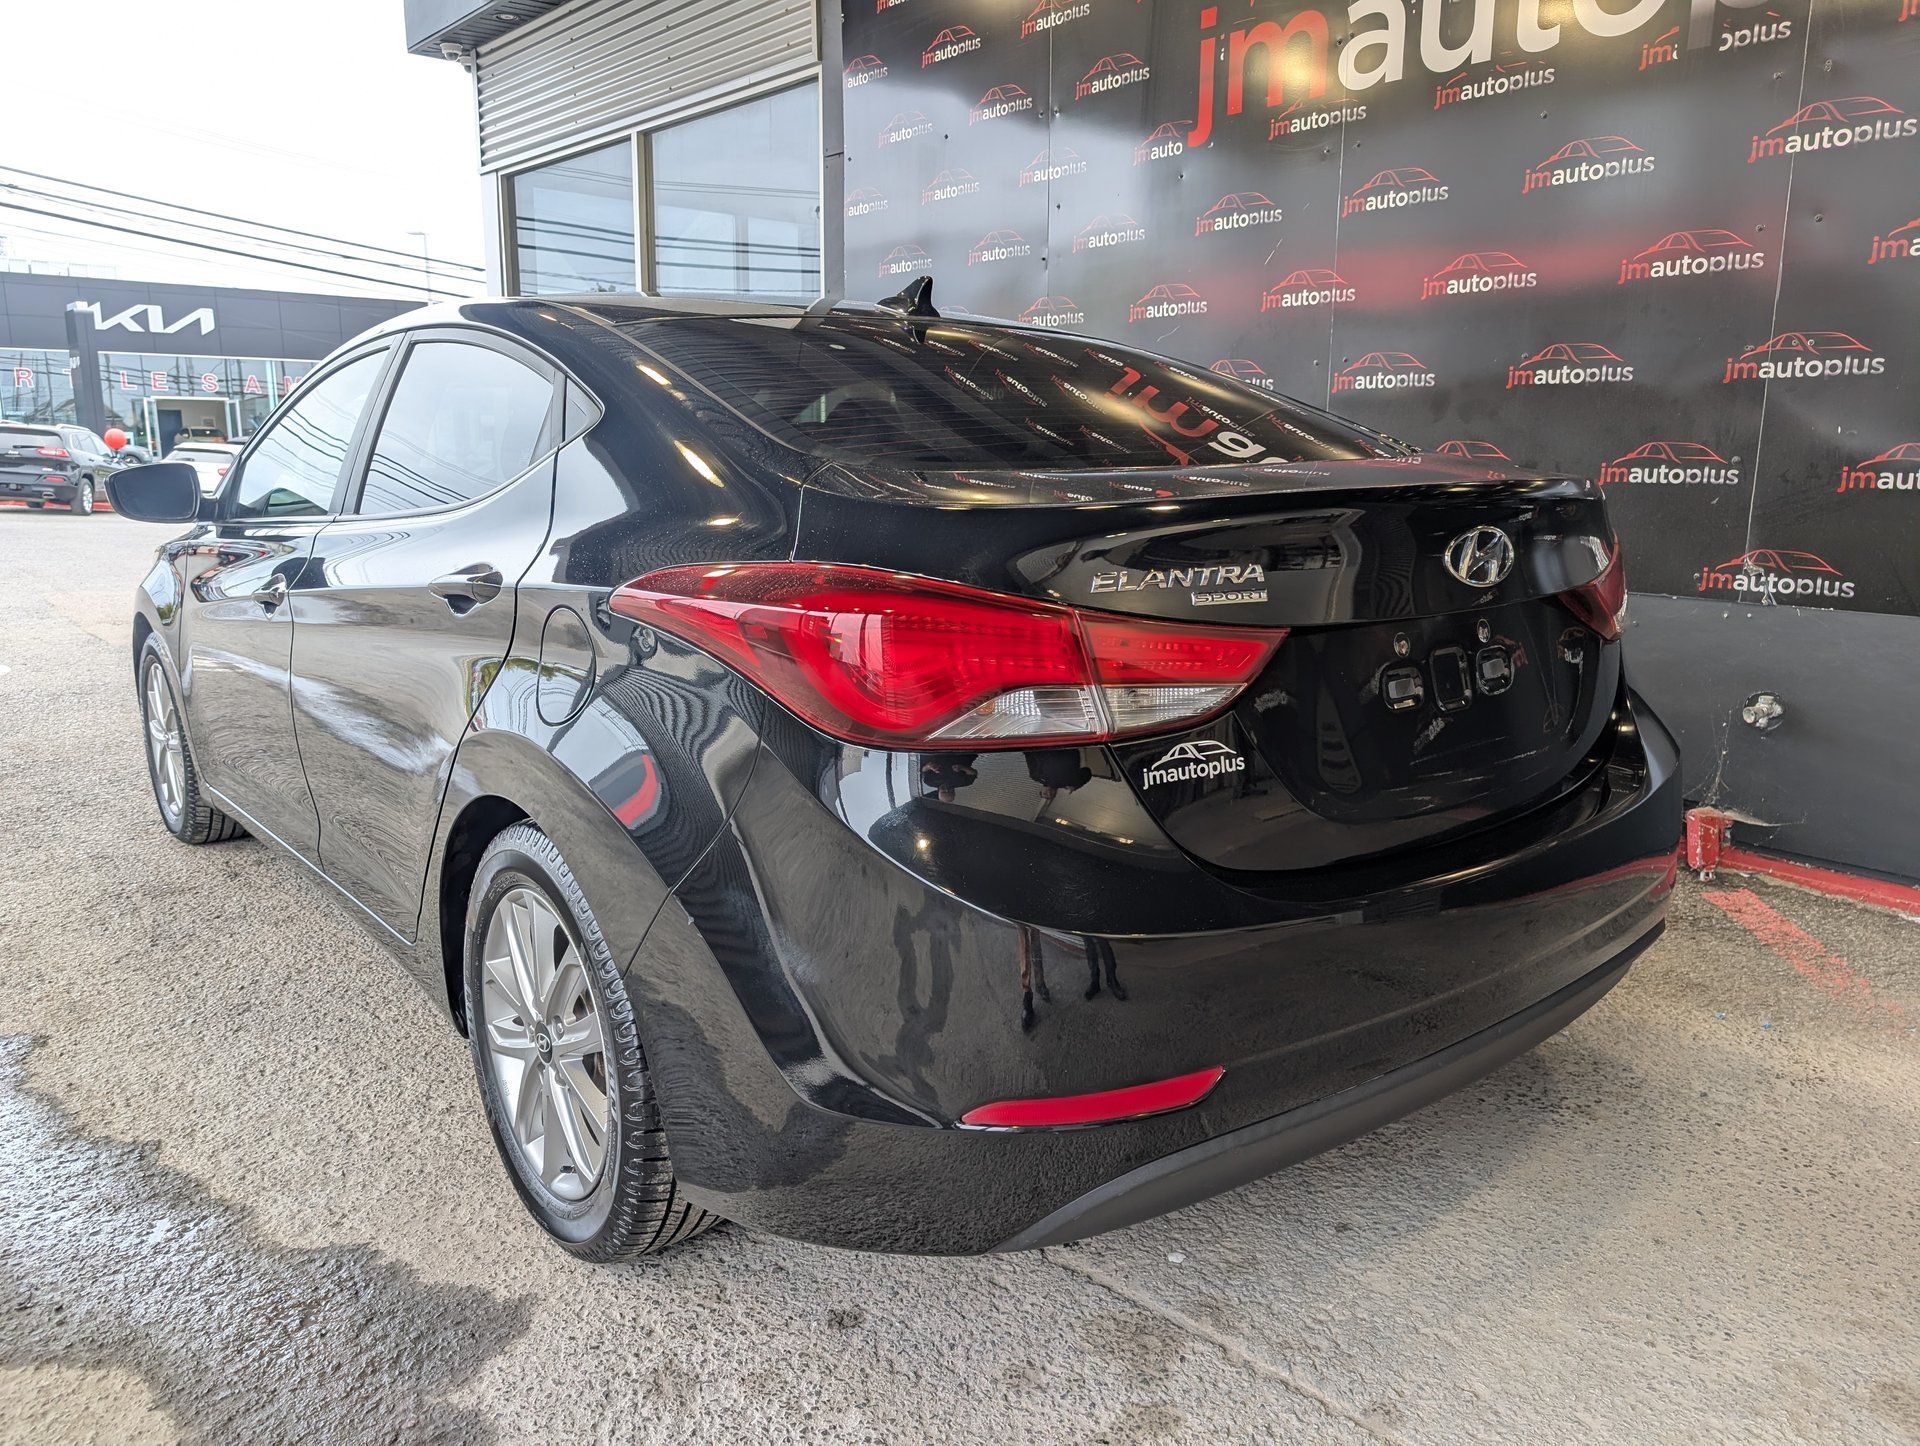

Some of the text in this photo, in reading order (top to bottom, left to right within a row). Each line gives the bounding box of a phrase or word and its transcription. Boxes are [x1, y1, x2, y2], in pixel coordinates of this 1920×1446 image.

[1020, 3, 1090, 39] jmautoplus
[921, 37, 981, 69] jmautoplus
[1075, 67, 1150, 100] jmautoplus
[1434, 67, 1555, 110] jmautoplus
[969, 96, 1033, 126] jmautoplus
[1268, 105, 1367, 140] jmautoplus
[878, 122, 933, 148] jmautoplus
[1748, 118, 1918, 163] jmautoplus
[1133, 141, 1183, 166] jmauto
[1019, 160, 1087, 187] jmautoplus
[1522, 155, 1655, 194] jmautoplus
[922, 181, 980, 206] jmautoplus
[1342, 185, 1449, 217] jmautoplus
[1195, 208, 1282, 236] jmautoplus
[1072, 228, 1145, 253] jmautoplus
[878, 258, 932, 278] jmautoplus
[968, 245, 1031, 268] jmautoplus
[1618, 251, 1765, 284] jmautoplus
[1260, 287, 1356, 312] jmautoplus
[1421, 272, 1537, 300] jmautoplus
[87, 301, 215, 336] KIA
[1129, 300, 1208, 323] jmautoplus
[1332, 371, 1436, 394] jmautoplus
[1506, 364, 1634, 389] jmautoplus
[1723, 355, 1885, 384] jmautoplus
[1599, 462, 1740, 486] jmautoplus
[1091, 563, 1266, 593] ELANTRA
[1699, 567, 1856, 598] jmautoplus
[1193, 589, 1268, 605] SPORT
[1142, 755, 1245, 790] jmautoplus
